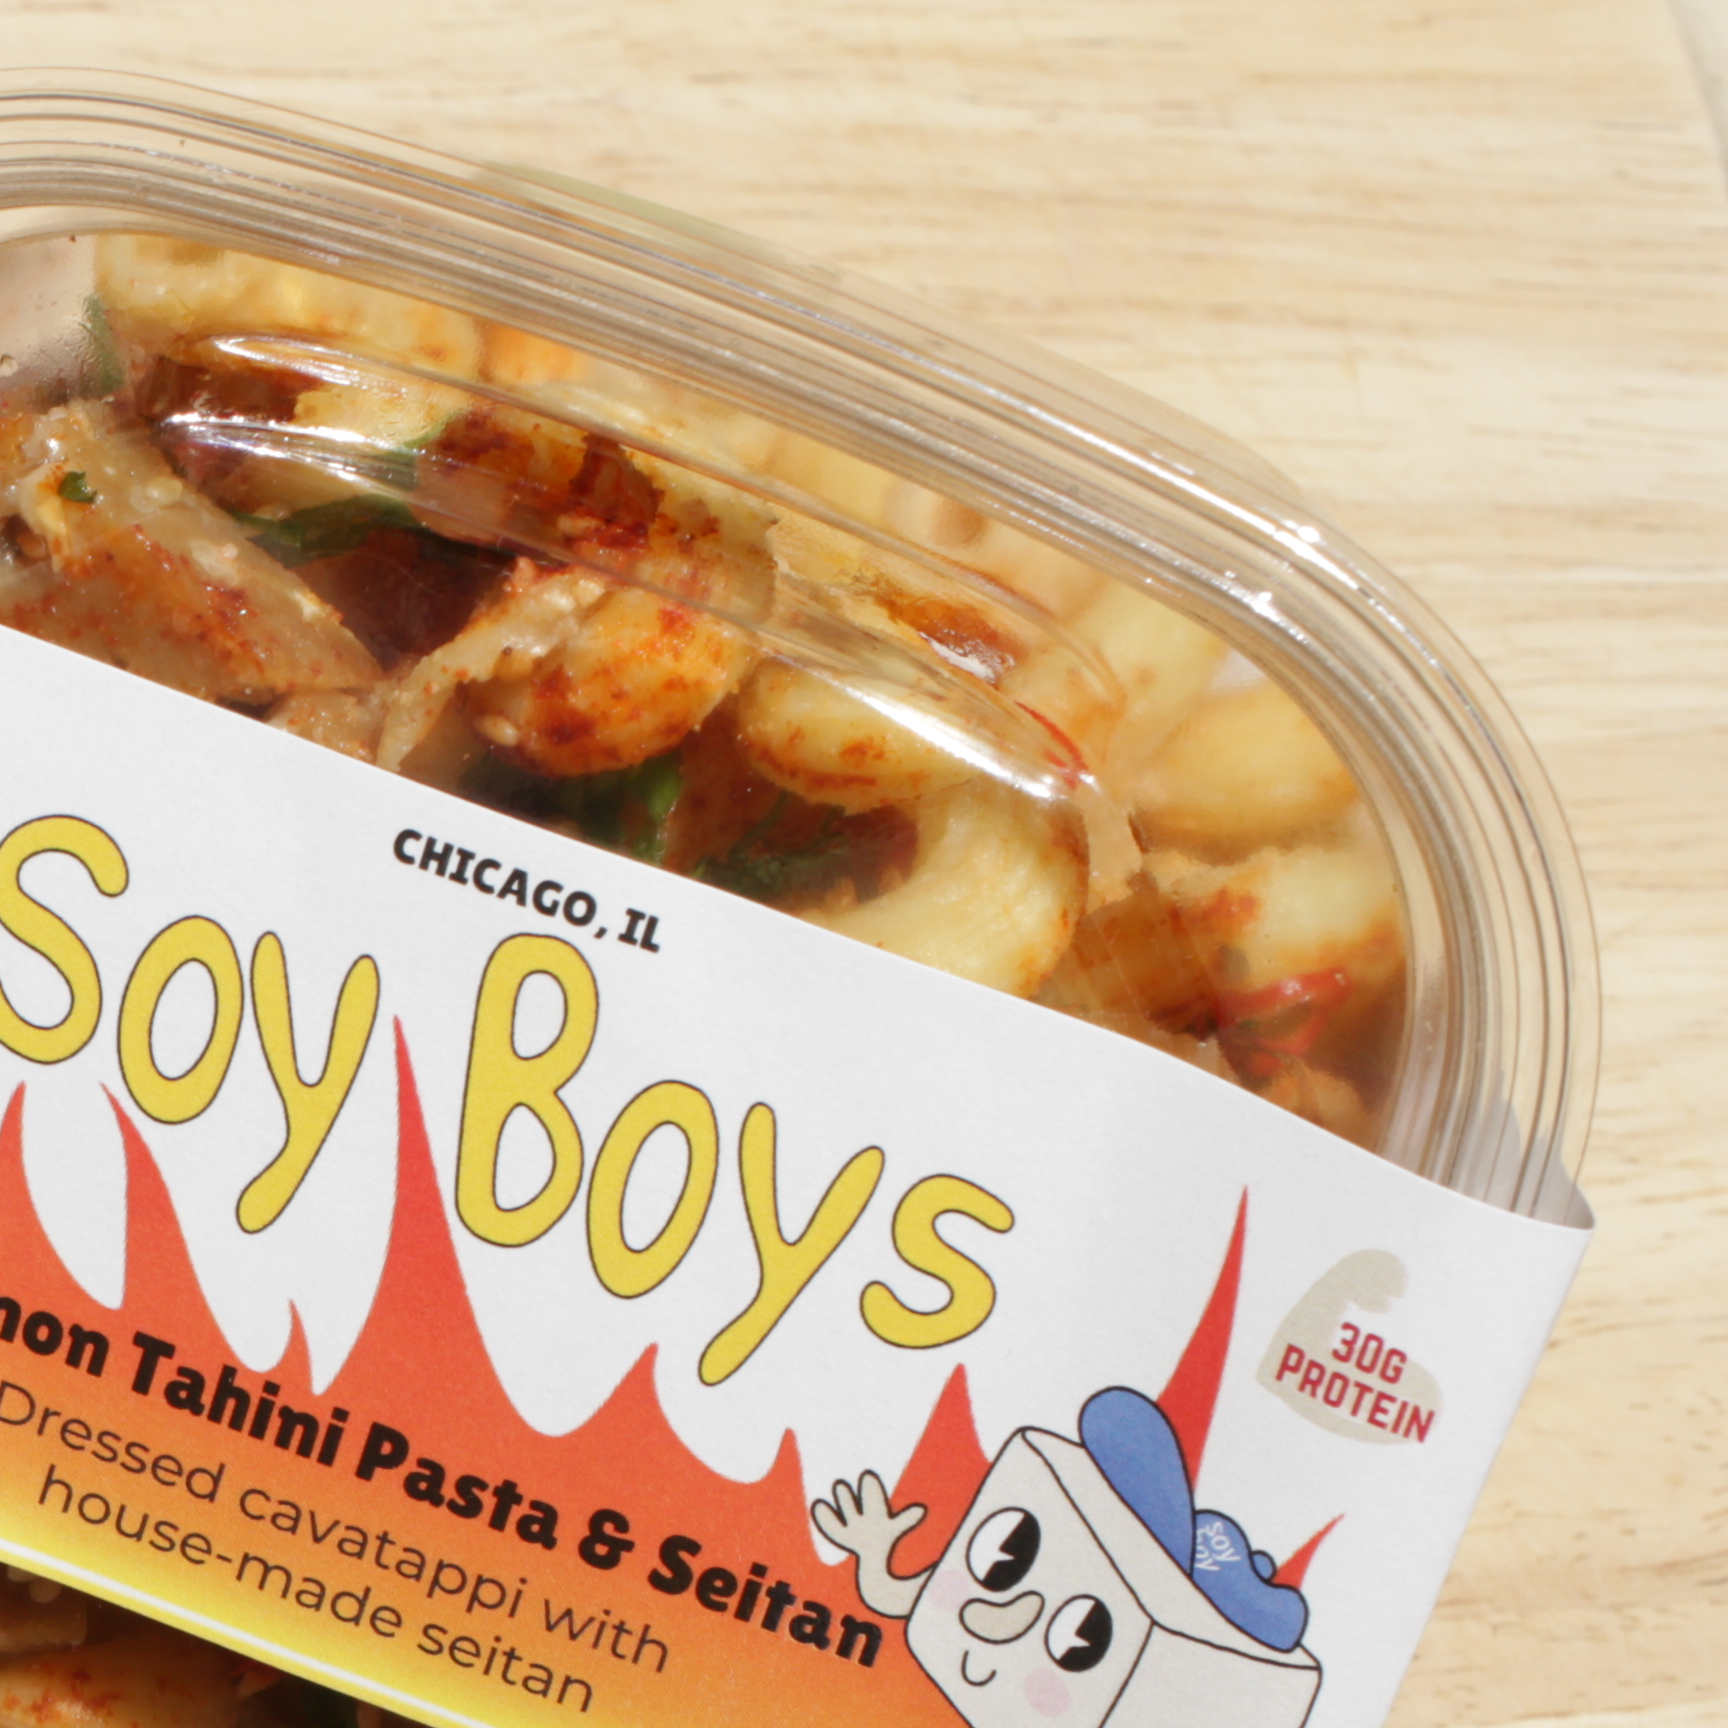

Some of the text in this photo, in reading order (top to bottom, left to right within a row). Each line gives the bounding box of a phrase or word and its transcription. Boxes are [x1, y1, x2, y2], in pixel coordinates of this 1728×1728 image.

[617, 907, 660, 954] IL
[1274, 1343, 1435, 1443] PROTEIN
[1331, 1321, 1408, 1385] 30G
[131, 1331, 350, 1467] Tahini
[355, 1421, 559, 1551] Pasta
[578, 1508, 636, 1570] &
[648, 1534, 885, 1668] Seitan
[38, 1463, 593, 1713] house-made seitan
[238, 1487, 528, 1619] cavatappi
[543, 1598, 669, 1673] with
